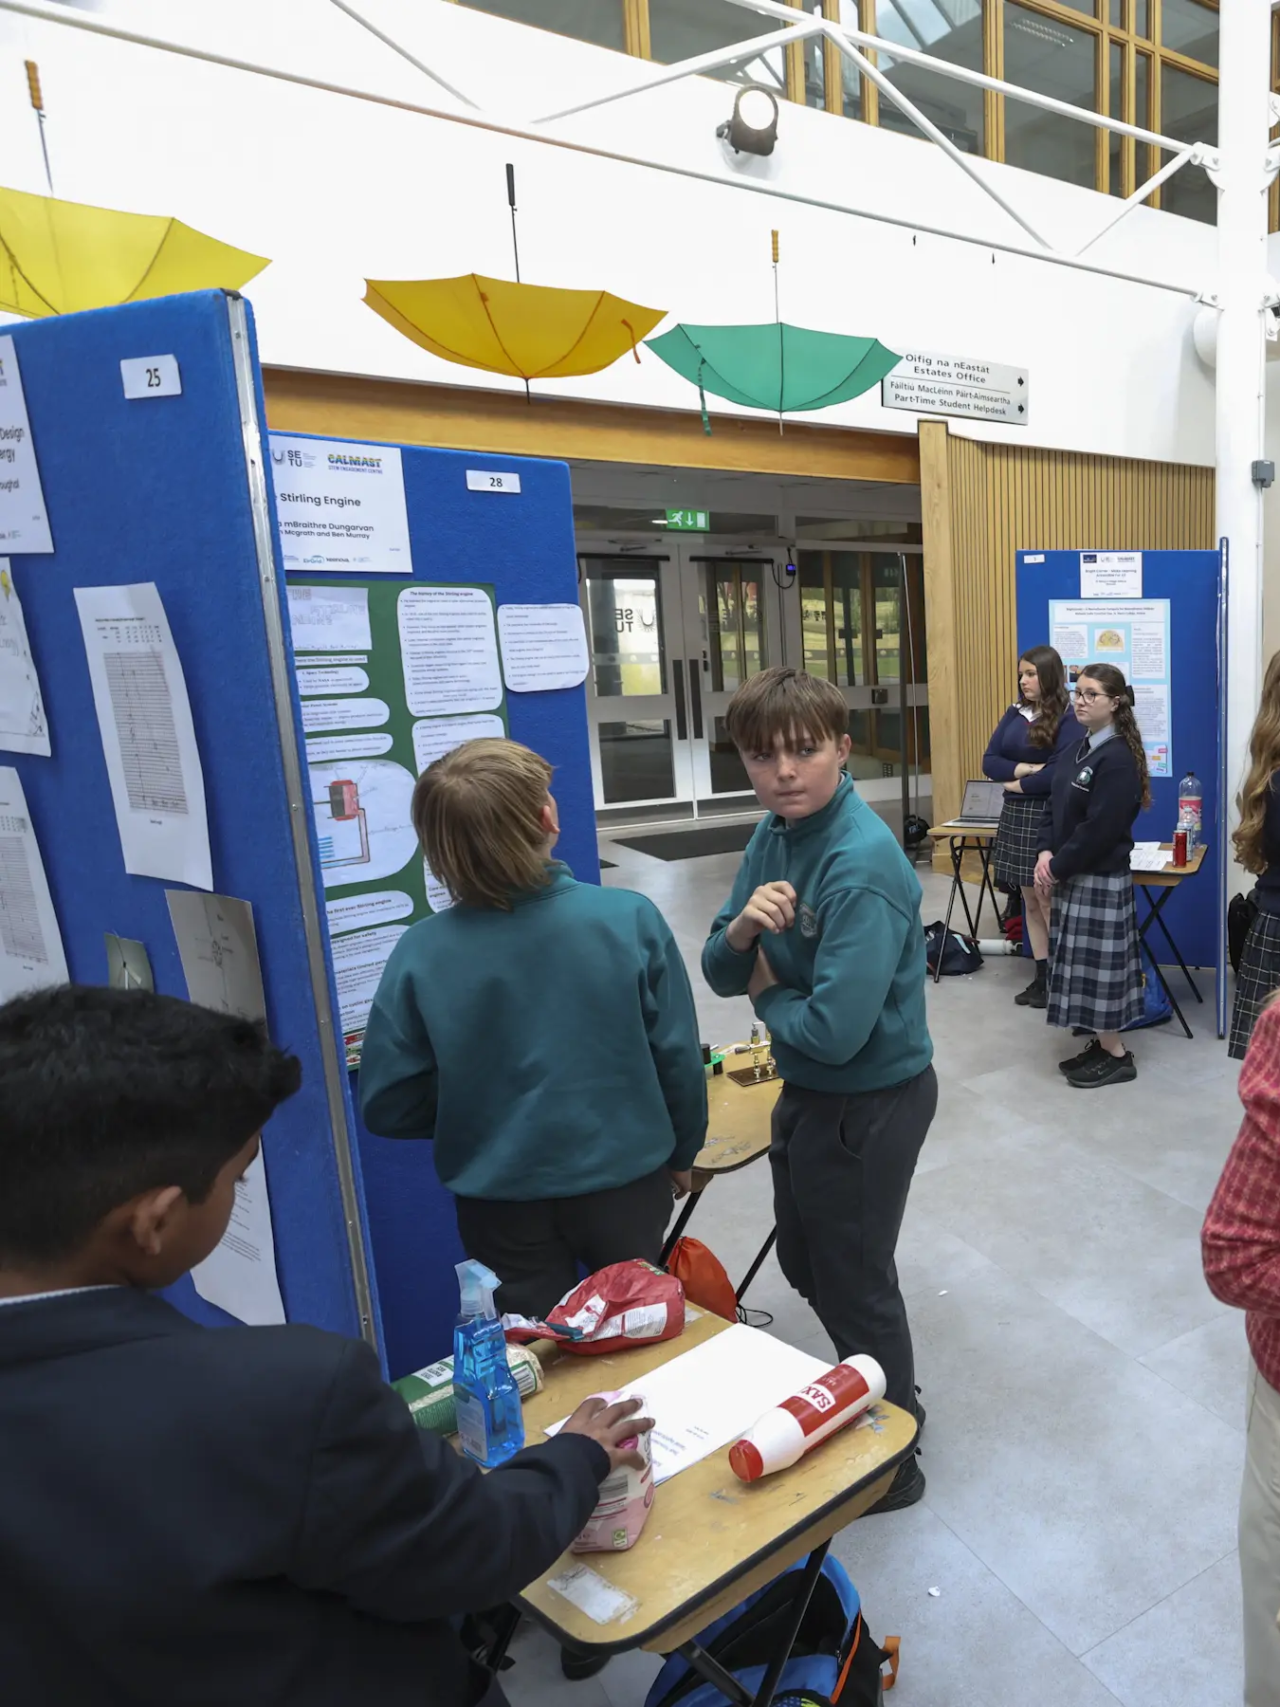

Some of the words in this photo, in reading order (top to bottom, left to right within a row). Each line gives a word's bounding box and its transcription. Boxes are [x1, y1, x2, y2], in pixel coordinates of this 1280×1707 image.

[905, 354, 932, 366] Oifig
[936, 359, 950, 367] na
[146, 368, 161, 387] 25
[914, 366, 952, 379] Estates
[956, 372, 986, 384] Office
[917, 384, 954, 396] MacLéinn
[894, 393, 936, 406] Part-Time
[939, 399, 971, 410] Student
[973, 402, 1006, 415] Helpdesk
[0, 425, 24, 442] Design
[287, 450, 302, 459] SE
[327, 454, 383, 468] CALMAST
[288, 459, 303, 468] TU
[489, 477, 503, 488] 28
[280, 493, 322, 507] Stirling
[323, 496, 361, 508] Engine
[285, 529, 316, 537] Mcgrath
[346, 532, 370, 540] Murray
[329, 523, 374, 533] Dungarvan
